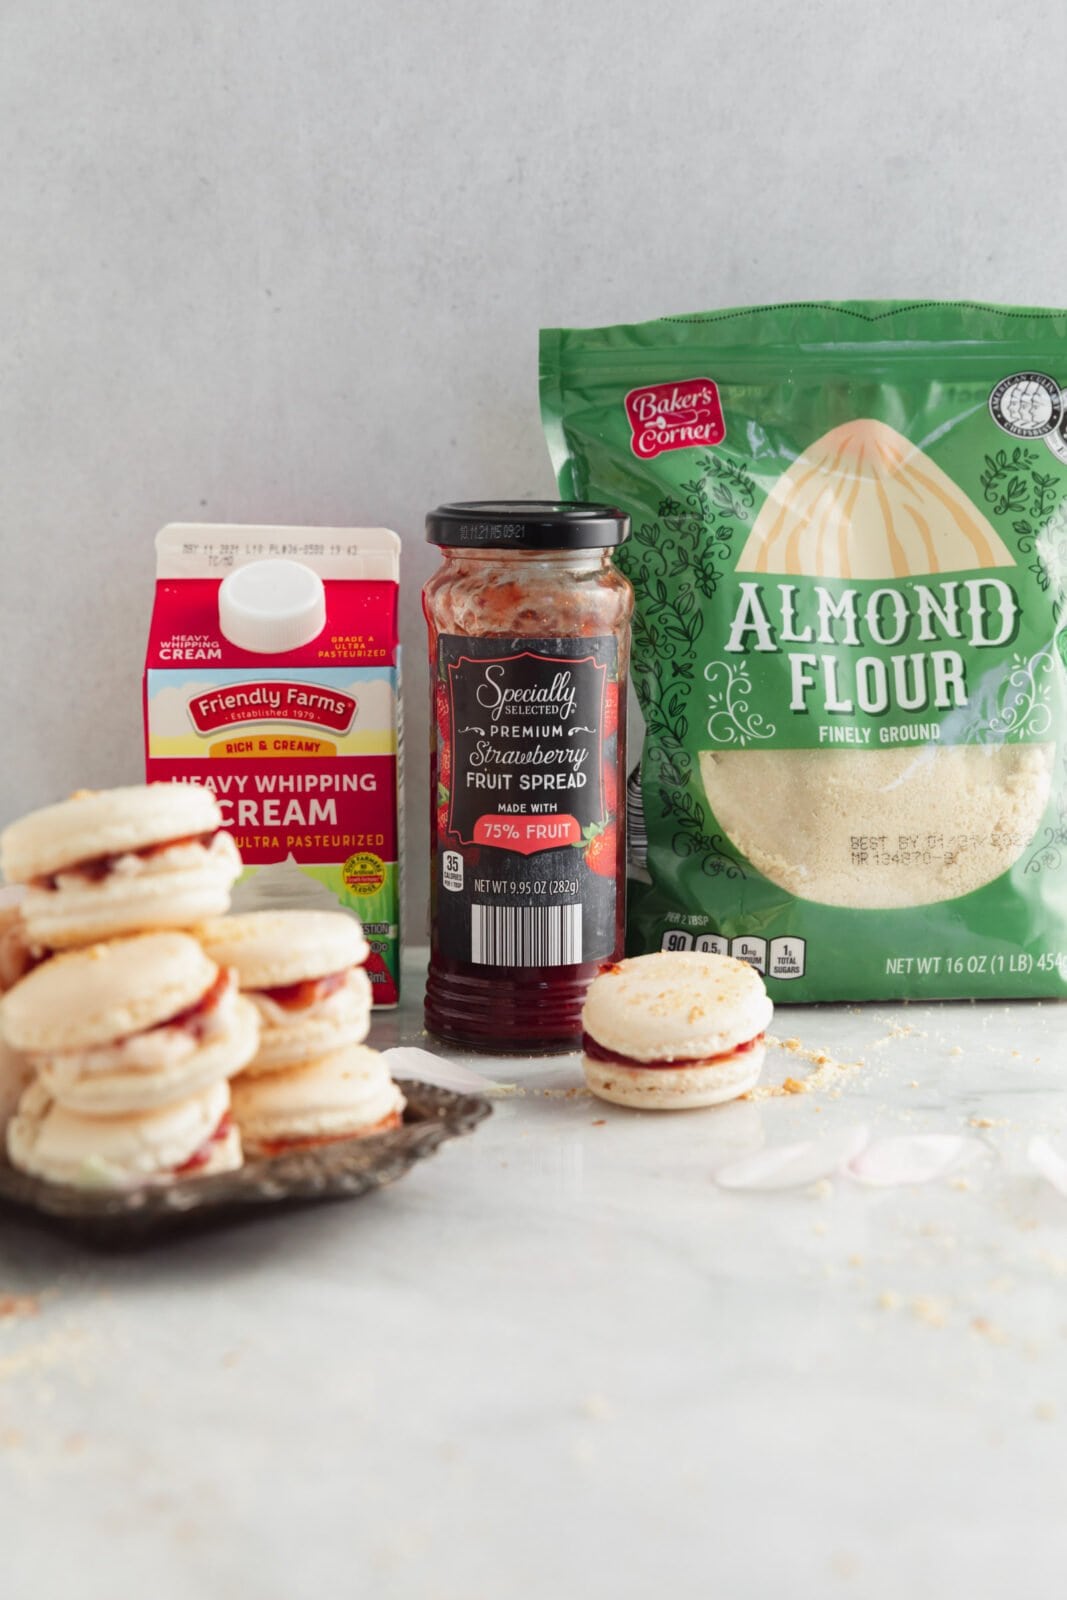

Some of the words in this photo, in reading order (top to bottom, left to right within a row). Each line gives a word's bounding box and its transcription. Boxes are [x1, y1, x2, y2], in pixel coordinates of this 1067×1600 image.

[632, 387, 712, 422] Baker's
[638, 422, 717, 453] Corner
[724, 579, 1022, 652] ALMOND
[159, 641, 219, 650] WHIPPING
[171, 634, 209, 642] HEAVY
[330, 636, 364, 644] GRADE
[158, 649, 222, 661] CREAM
[318, 649, 387, 659] PASTEURIZED
[788, 650, 968, 714] FLOUR
[476, 664, 577, 721] Specially
[198, 687, 281, 718] Friendly
[286, 688, 346, 715] Farms
[504, 704, 559, 716] SELECTED
[230, 709, 289, 721] Established
[292, 709, 315, 720] 1979
[490, 724, 563, 738] PREMIUM
[818, 725, 871, 744] FINELY
[879, 723, 940, 743] GROUND
[226, 743, 253, 754] RICH
[258, 740, 268, 751] &
[273, 740, 321, 753] CREAMY
[468, 740, 589, 771] Strawberry
[254, 773, 377, 794] WHIPPING
[466, 772, 513, 791] FRUIT
[519, 772, 588, 790] SPREAD
[215, 798, 338, 827] CREAM
[497, 804, 527, 813] MADE
[531, 803, 558, 813] WITH
[484, 823, 520, 839] 75%
[526, 823, 572, 839] FRUIT
[235, 836, 280, 849] ULTRA
[286, 834, 385, 848] PASTEURIZED
[850, 836, 888, 850] BEST
[898, 834, 919, 850] BY
[446, 855, 460, 872] 35
[474, 879, 491, 893] NET
[491, 881, 508, 894] WT
[510, 881, 531, 894] 9.95
[533, 881, 547, 894] OZ
[549, 878, 579, 895] (282g)
[667, 934, 687, 951] 90
[777, 957, 797, 965] TOTAL
[886, 957, 913, 974] NET
[917, 956, 942, 973] WT
[947, 957, 963, 973] 16
[967, 955, 987, 972] OZ
[991, 956, 1004, 974] (1
[1009, 954, 1033, 974] LB)
[773, 966, 800, 974] SUGARS
